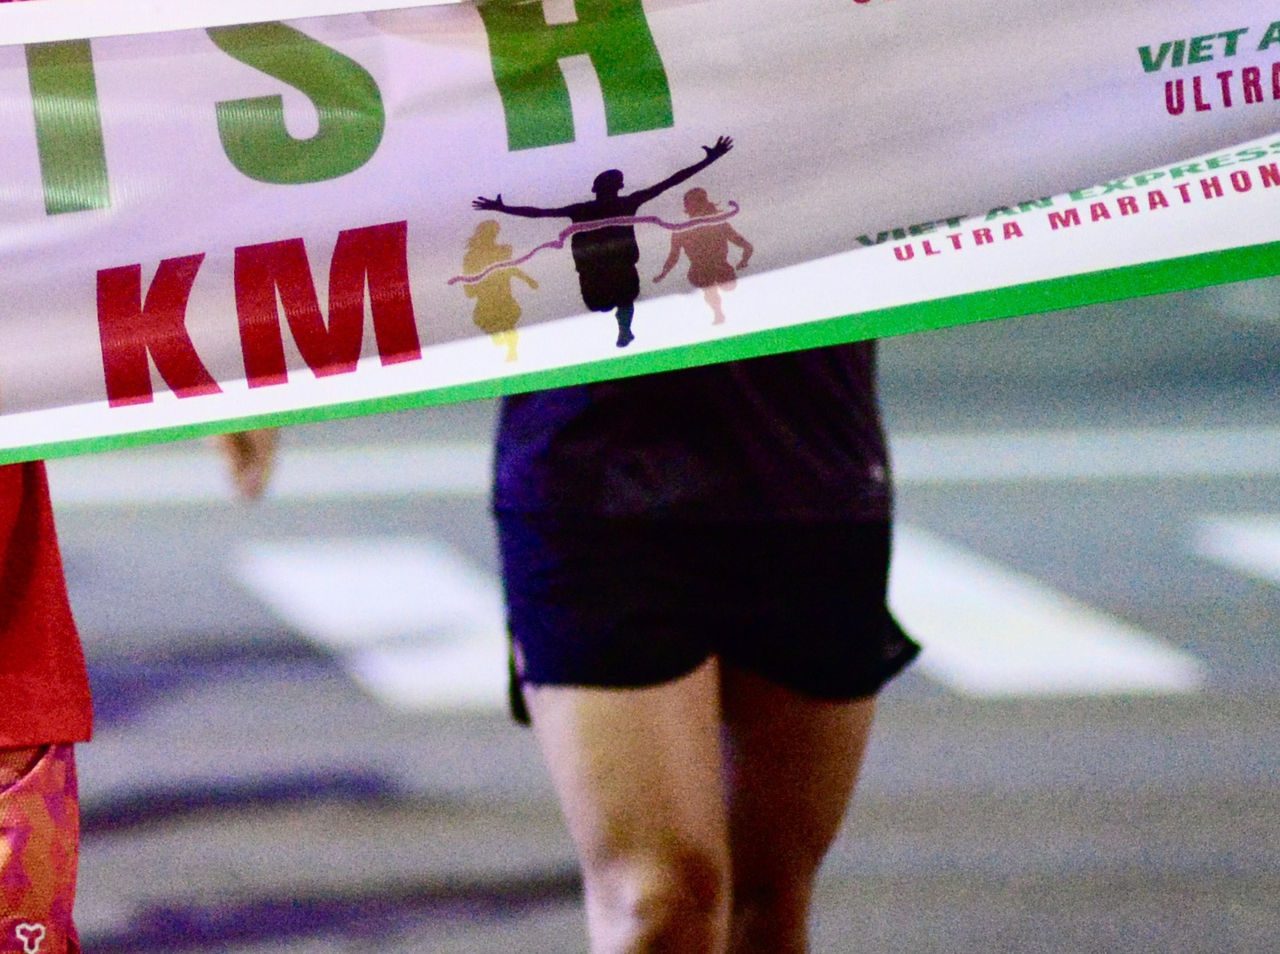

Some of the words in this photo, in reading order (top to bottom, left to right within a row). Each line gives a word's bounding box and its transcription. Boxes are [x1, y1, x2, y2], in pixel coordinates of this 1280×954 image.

[1137, 26, 1250, 74] VIET
[893, 221, 1025, 263] ULTRA
[1046, 162, 1280, 230] MARATHON
[96, 218, 424, 410] KM
